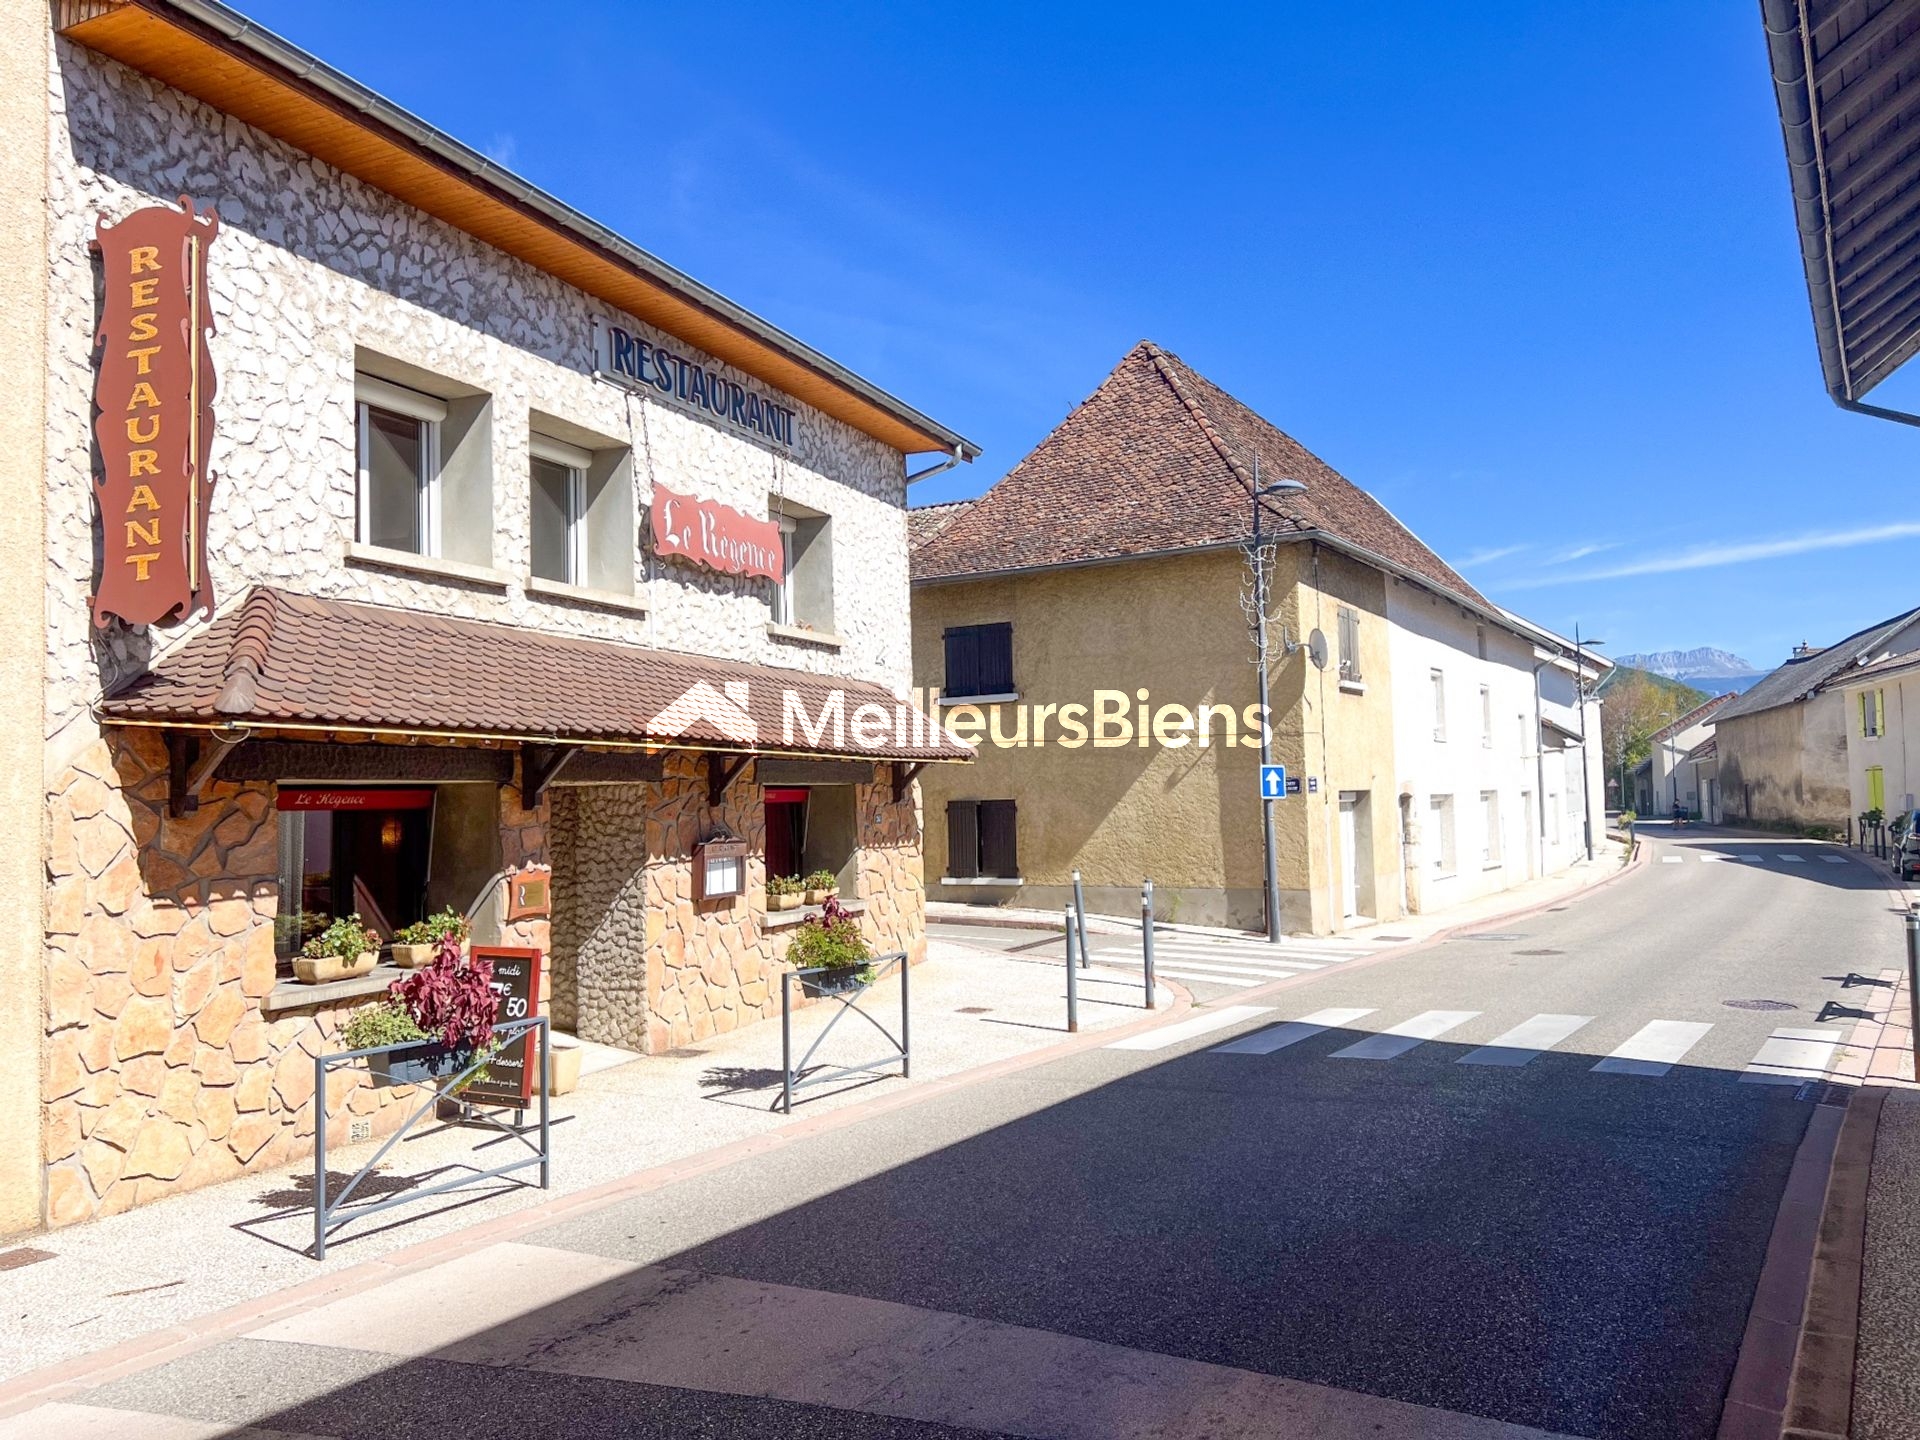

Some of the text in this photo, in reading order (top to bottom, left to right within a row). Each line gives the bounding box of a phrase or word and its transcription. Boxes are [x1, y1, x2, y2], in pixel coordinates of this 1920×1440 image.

[125, 245, 163, 582] RESTAURANT
[610, 327, 796, 447] RESTAURANT
[663, 499, 692, 550] Le
[294, 793, 312, 805] Le
